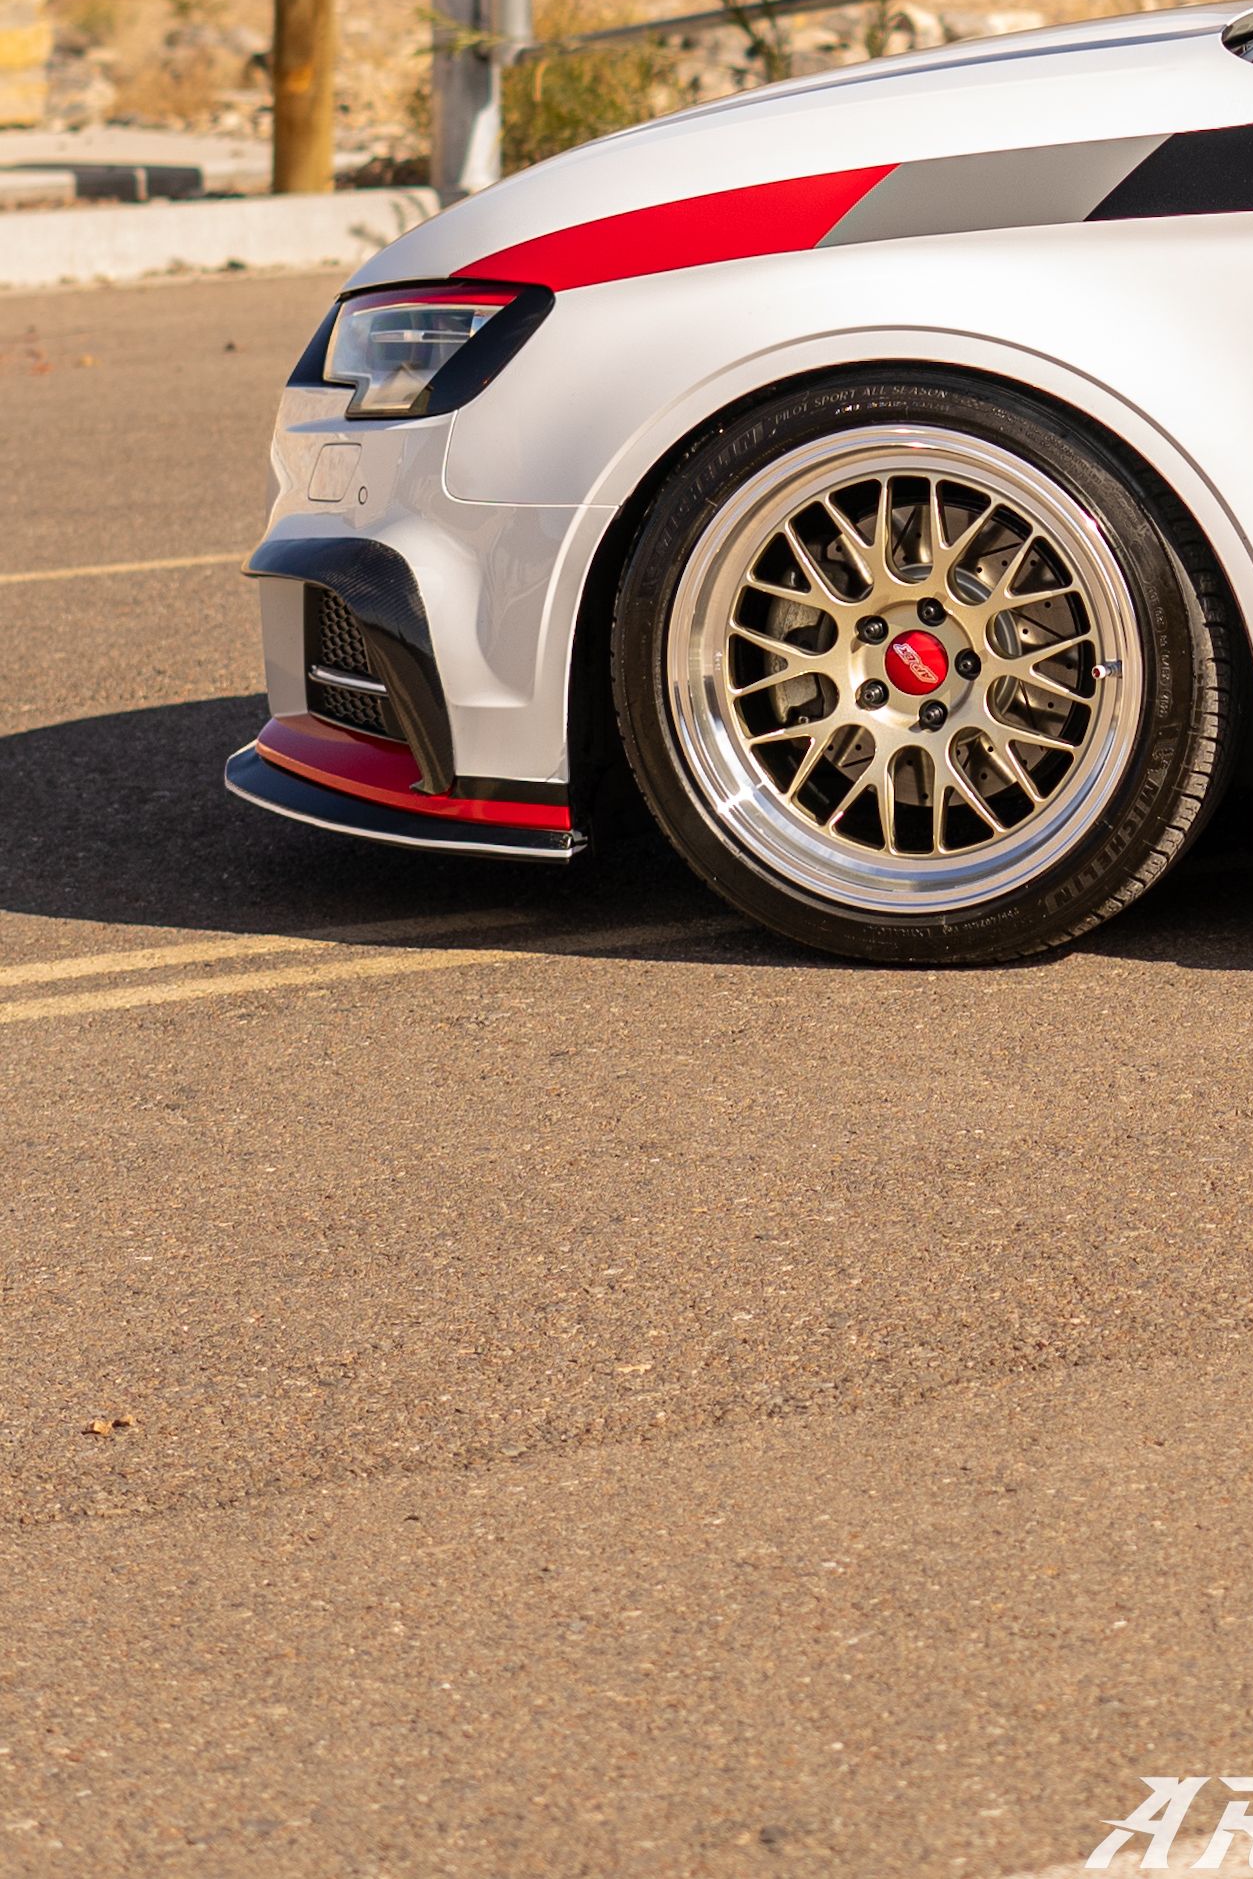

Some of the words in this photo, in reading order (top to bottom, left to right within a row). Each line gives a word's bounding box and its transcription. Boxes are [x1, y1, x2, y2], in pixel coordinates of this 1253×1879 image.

[775, 402, 809, 424] PILOT
[814, 389, 857, 408] SPORT
[862, 385, 887, 397] ALL
[893, 385, 949, 399] SEASON
[1053, 776, 1161, 908] MICHELIN
